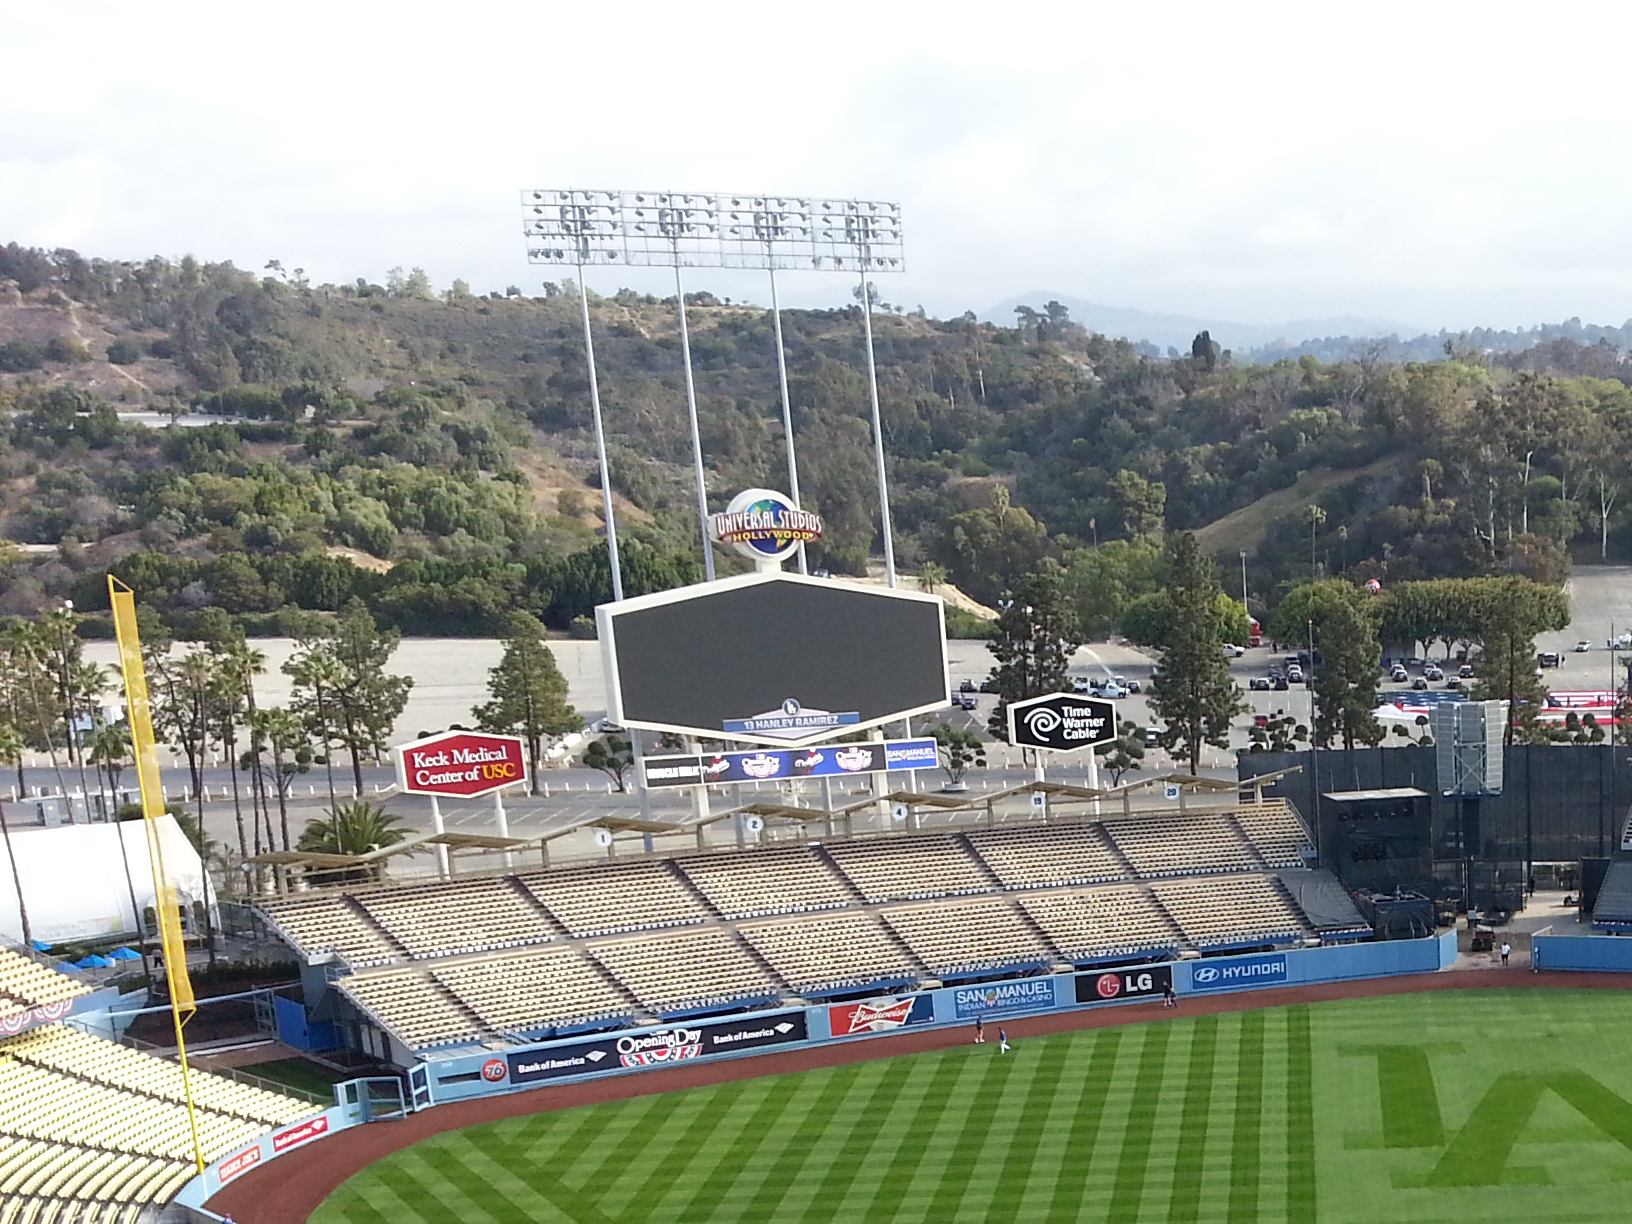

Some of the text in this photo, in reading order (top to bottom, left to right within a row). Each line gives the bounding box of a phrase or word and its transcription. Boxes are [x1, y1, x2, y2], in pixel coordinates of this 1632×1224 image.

[717, 510, 822, 534] UNIVERSAL STUDIOS
[733, 531, 810, 542] HOLLYWOOD
[1061, 706, 1092, 717] Time
[743, 714, 839, 730] 13 HANLEY RAMIREZ
[1062, 717, 1106, 729] Warner
[1063, 728, 1099, 739] Cable
[413, 746, 507, 768] Keck Medical
[416, 763, 516, 786] Center of USC
[1222, 962, 1285, 979] HYUNDAI
[1126, 974, 1153, 992] LG
[957, 981, 1052, 1004] SAN MANUEL
[958, 1001, 985, 1011] INDIAN
[848, 1008, 913, 1025] Budweiser
[617, 1029, 702, 1054] Opening Day
[714, 1028, 774, 1044] Bank of America
[485, 1064, 502, 1079] 76
[518, 1057, 585, 1073] Bank of America
